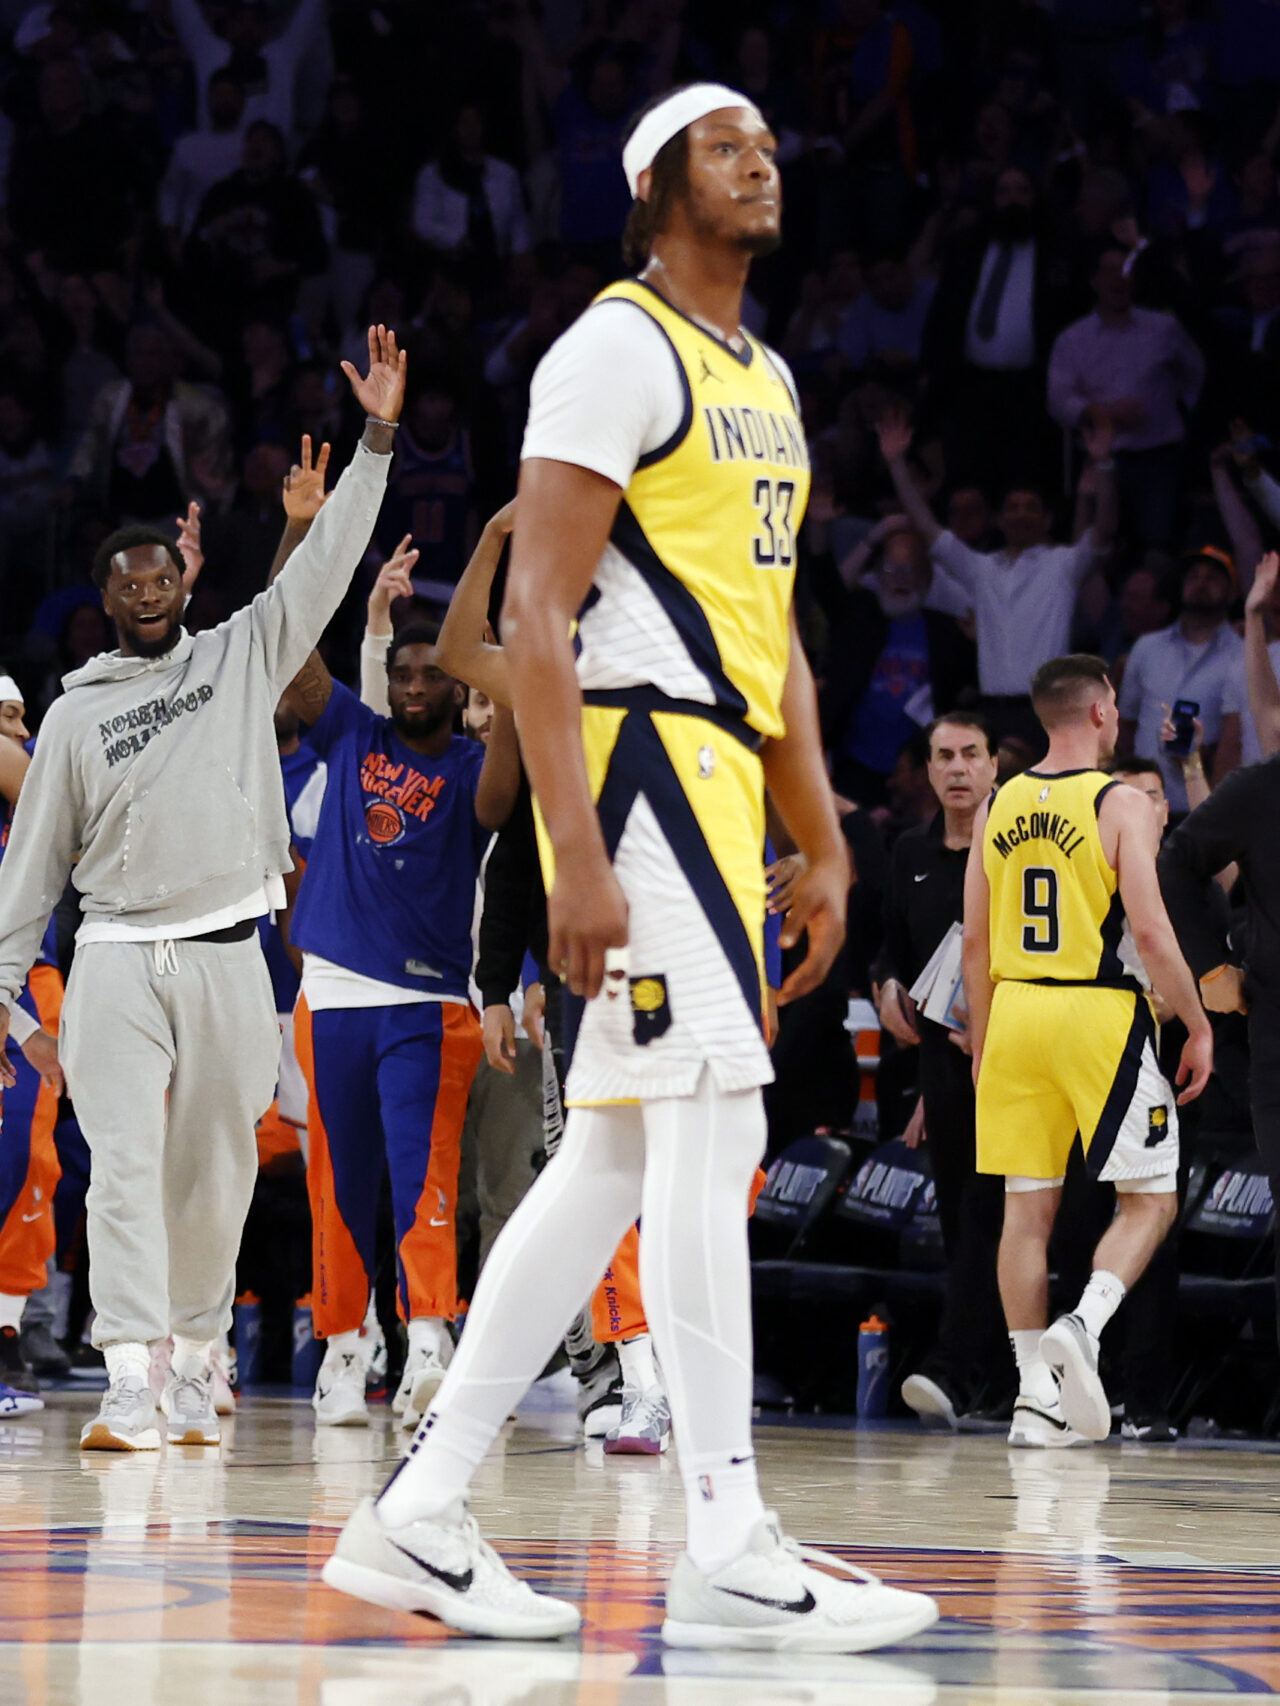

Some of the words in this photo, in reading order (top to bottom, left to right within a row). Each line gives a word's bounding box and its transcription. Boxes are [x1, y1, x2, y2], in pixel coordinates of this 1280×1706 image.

[705, 407, 810, 469] INDIAN
[753, 478, 797, 567] 33
[362, 752, 405, 781] NEW
[404, 768, 447, 798] YOK
[1022, 867, 1060, 953] 9
[605, 1287, 621, 1332] Knicks
